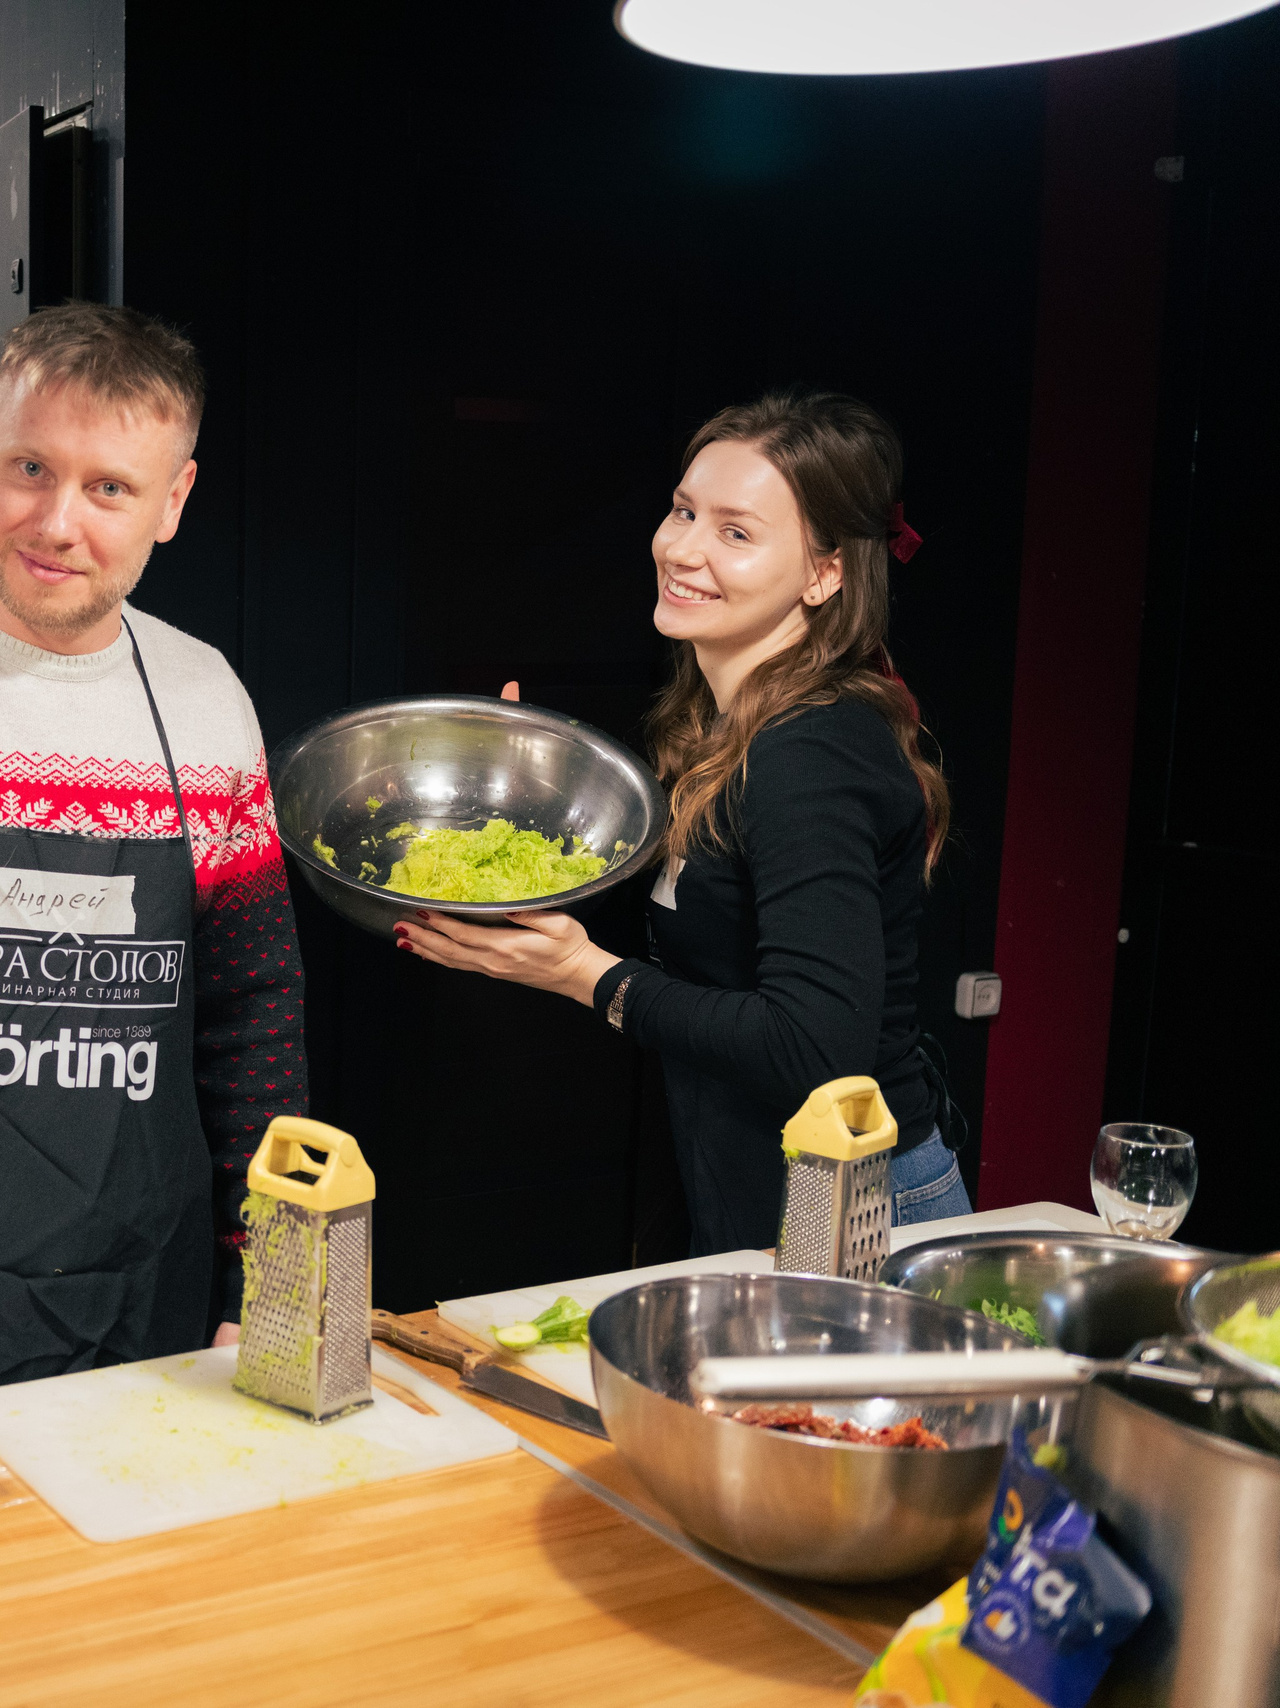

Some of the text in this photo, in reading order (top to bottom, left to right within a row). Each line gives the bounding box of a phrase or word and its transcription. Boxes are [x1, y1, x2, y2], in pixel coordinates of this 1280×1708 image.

[0, 877, 109, 917] Андрей
[40, 947, 178, 984] СТОЛОВ
[85, 987, 141, 1000] СТУДИЯ
[92, 1025, 152, 1038] since 1889
